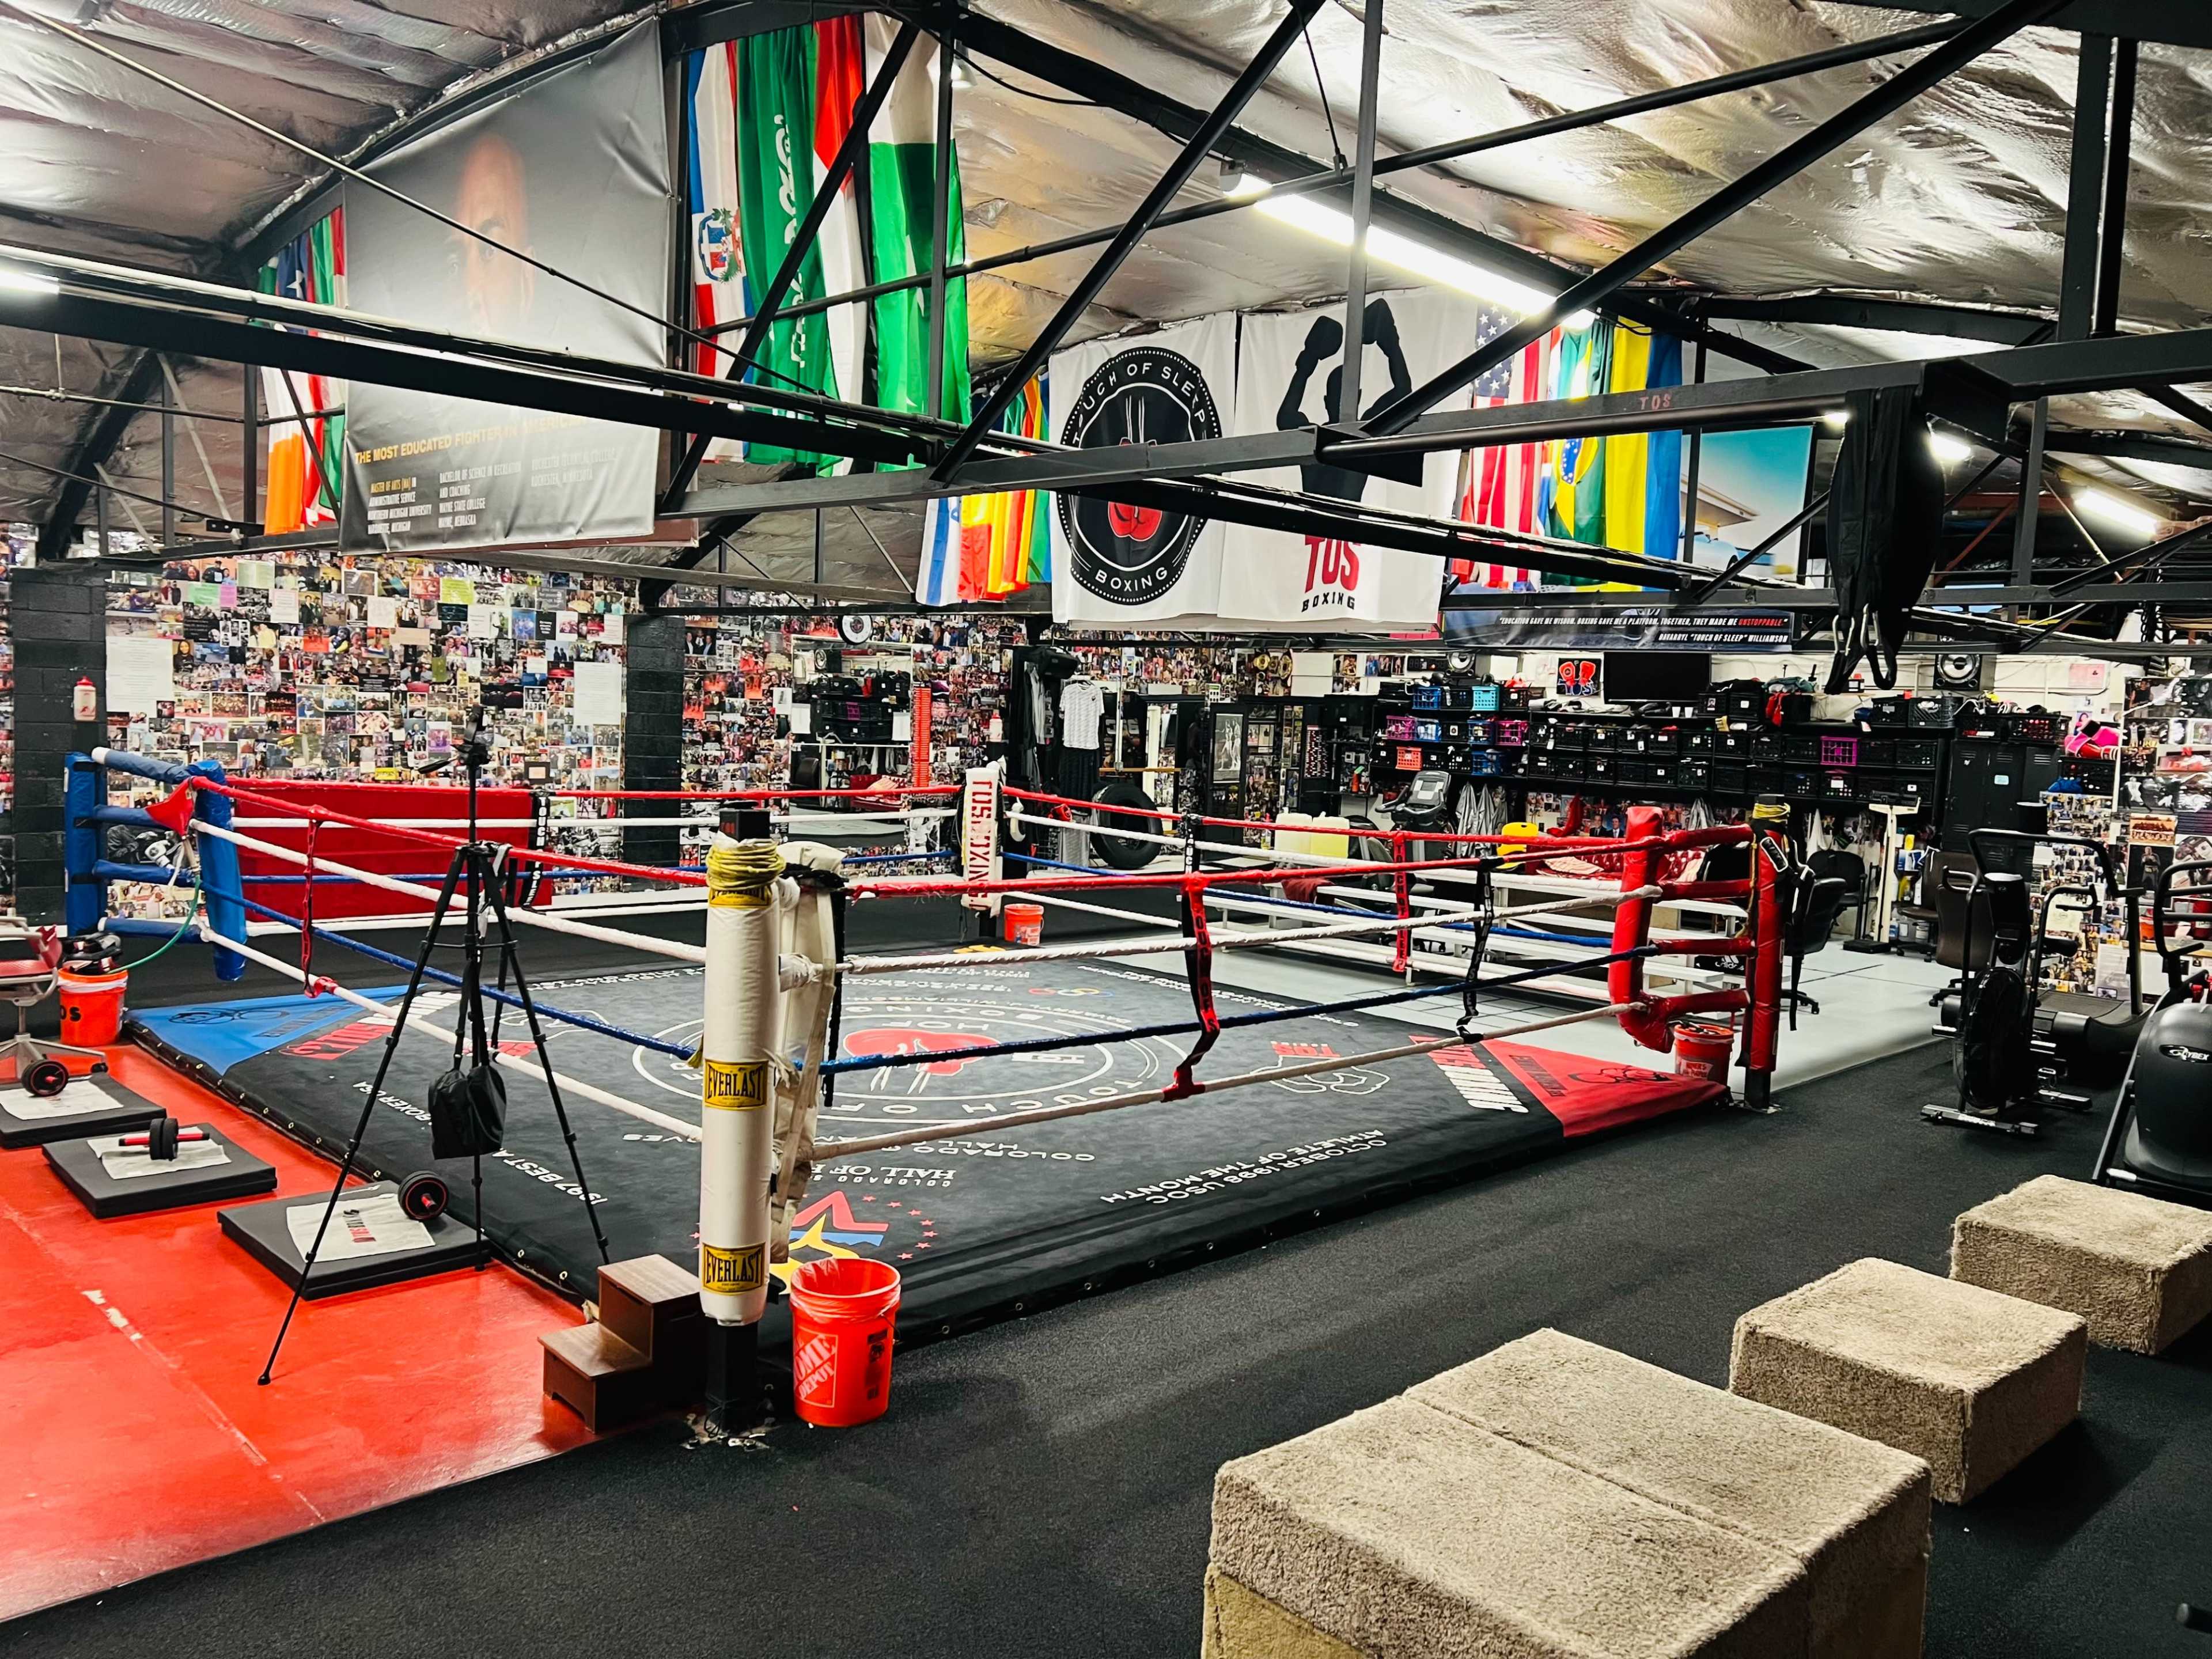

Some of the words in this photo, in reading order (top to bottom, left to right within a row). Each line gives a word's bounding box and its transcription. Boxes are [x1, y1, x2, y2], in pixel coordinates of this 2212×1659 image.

[1127, 362, 1152, 376] OF
[1639, 393, 1672, 410] TOS
[355, 450, 372, 464] THE
[373, 445, 399, 461] MOST
[400, 435, 452, 456] EDUCATED
[455, 426, 499, 448] FIGHTER
[440, 469, 461, 484] BACHELOR
[468, 466, 486, 480] SCIENCE
[449, 484, 471, 497] COACHING
[454, 499, 466, 512] STATE
[467, 498, 486, 510] COLLEGE
[1304, 535, 1361, 594] TOS
[1094, 566, 1168, 592] BOXING
[1301, 592, 1356, 613] BOXING
[1577, 618, 1597, 626] BOXING
[1598, 618, 1613, 626] GAVE
[1613, 618, 1622, 626] ME
[1693, 618, 1708, 626] THEY
[1708, 618, 1727, 626] MADE
[1727, 618, 1738, 626] ME
[1748, 635, 1789, 643] WILLIAMSON
[536, 796, 547, 846] TOUCH
[1482, 872, 1494, 937] TOUCH
[881, 1020, 990, 1031] HOF
[1271, 1043, 1342, 1058] TOS
[707, 1063, 764, 1100] EVERLAST
[961, 1080, 1143, 1113] TOUCH
[831, 1102, 919, 1115] OF
[937, 1140, 1018, 1151] HALL
[1286, 1128, 1385, 1156] ATHLETE
[1257, 1152, 1288, 1166] OF
[1277, 1138, 1387, 1169] OCTOBER
[502, 1157, 565, 1183] BEST
[830, 1164, 872, 1176] OF
[880, 1166, 956, 1180] HALL
[1200, 1160, 1256, 1179] THE
[1223, 1165, 1281, 1185] 1998
[837, 1175, 952, 1188] COLORADO
[1100, 1174, 1204, 1204] MONTH
[1145, 1180, 1226, 1205] USOC
[706, 1247, 762, 1284] EVERLAST
[795, 1334, 836, 1381] OME
[798, 1361, 835, 1399] DEPOT
